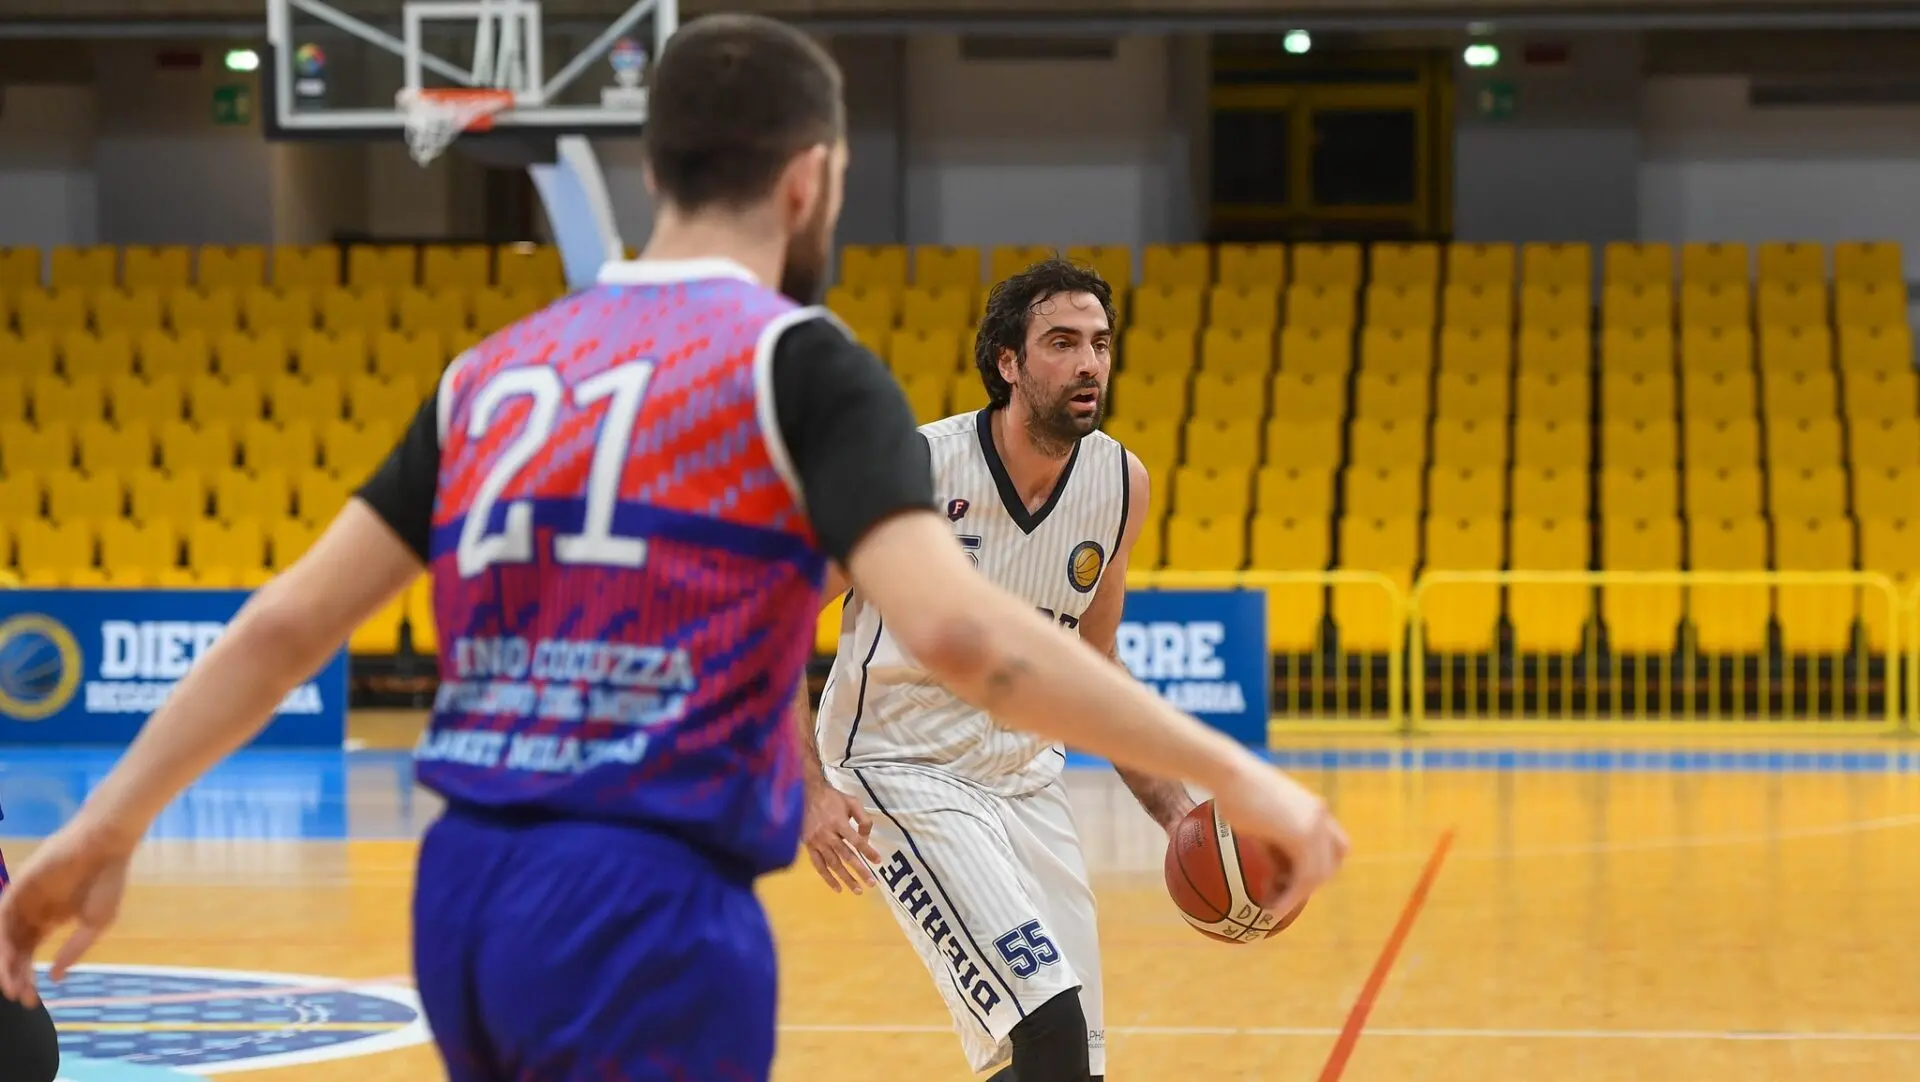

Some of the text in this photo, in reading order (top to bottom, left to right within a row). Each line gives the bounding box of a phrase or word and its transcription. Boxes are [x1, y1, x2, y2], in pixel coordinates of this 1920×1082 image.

[457, 360, 654, 579] 21
[99, 619, 229, 680] DIE
[531, 637, 697, 691] COCUZZA
[1116, 620, 1226, 681] RRE
[992, 918, 1062, 980] 55
